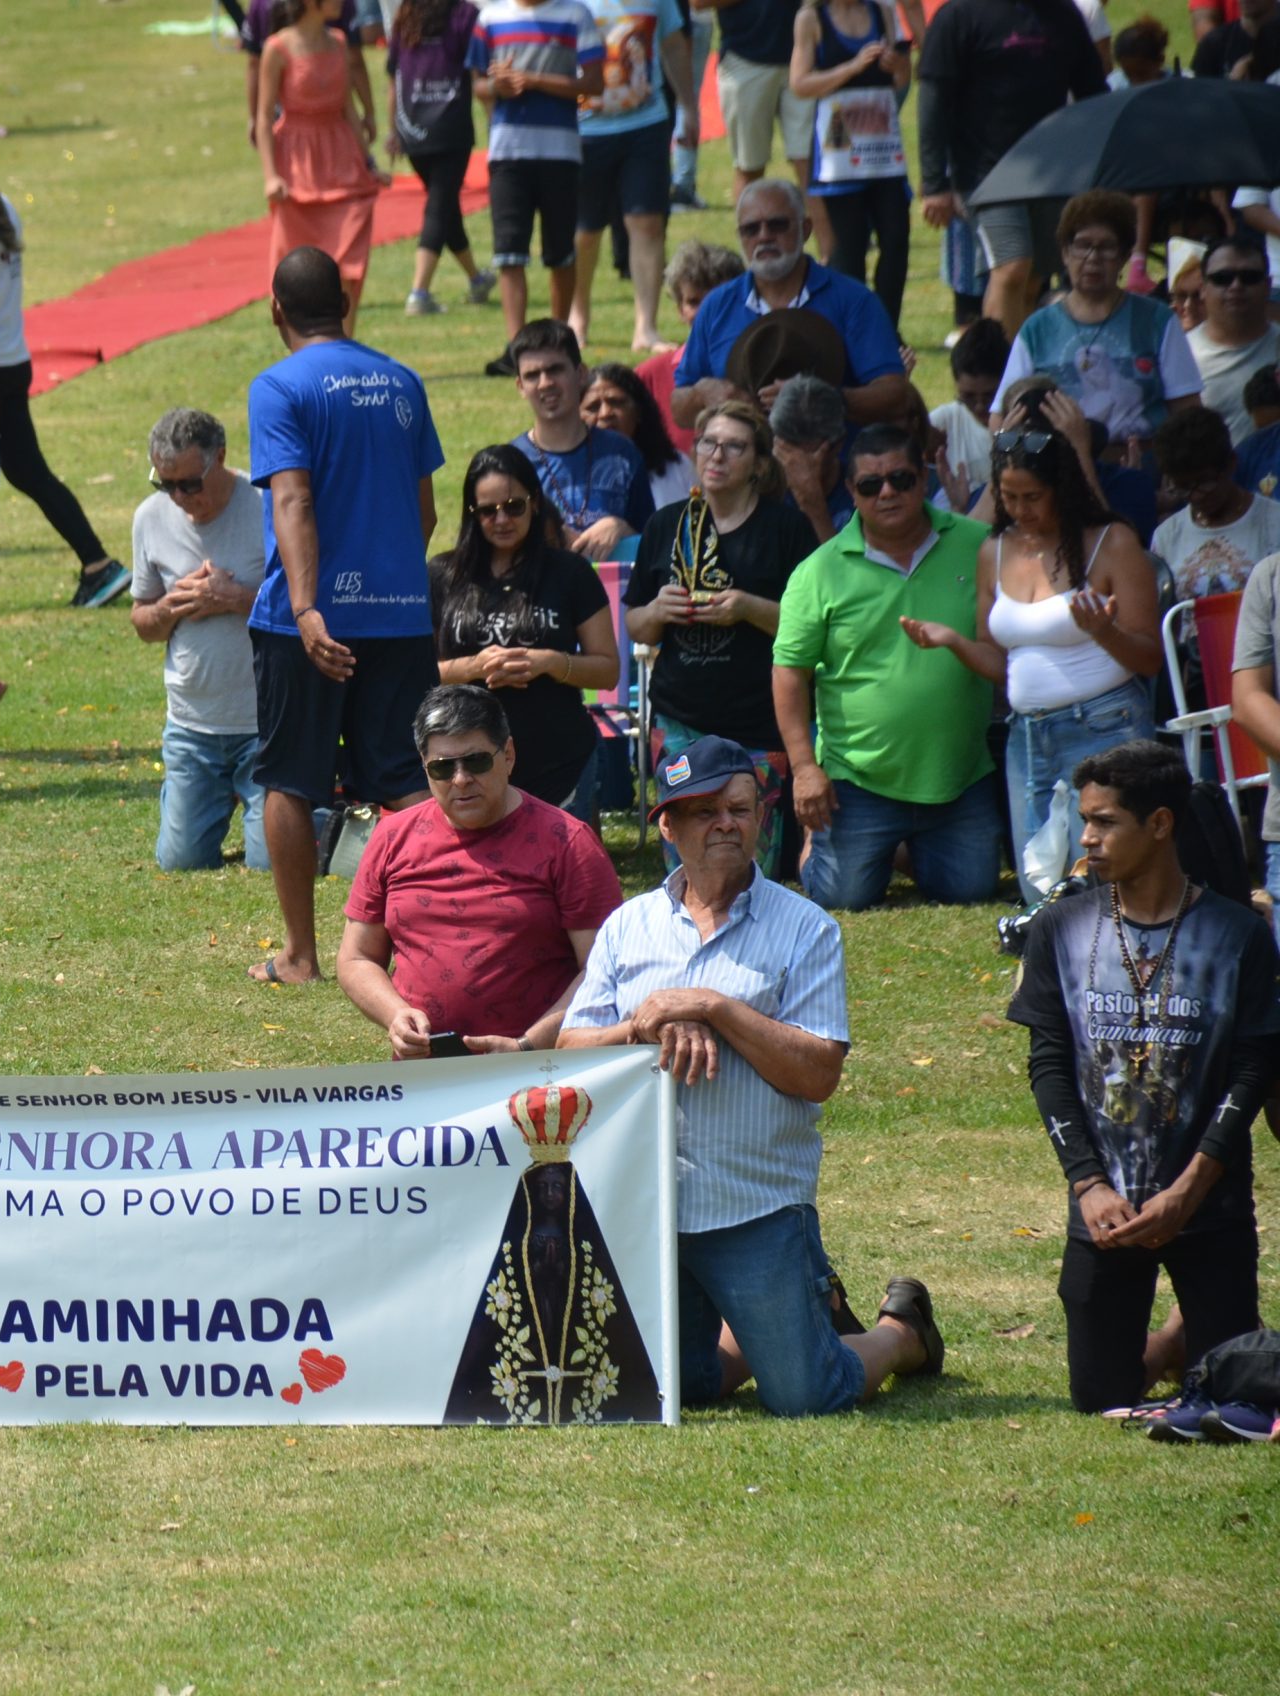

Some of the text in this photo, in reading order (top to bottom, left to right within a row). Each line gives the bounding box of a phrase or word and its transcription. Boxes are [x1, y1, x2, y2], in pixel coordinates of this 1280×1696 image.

[1085, 990, 1201, 1018] Pastorl dos
[17, 1093, 108, 1107] SENHOR
[113, 1091, 166, 1106] BOM
[170, 1089, 238, 1105] JESUS
[256, 1087, 308, 1104] VILA
[312, 1084, 404, 1104] VARGAS
[211, 1125, 511, 1169] APARECIDA
[79, 1188, 106, 1217] O
[122, 1187, 235, 1217] POVO
[251, 1187, 302, 1216] DE
[319, 1185, 429, 1215] DEUS
[35, 1363, 274, 1398] PELA VIDA
